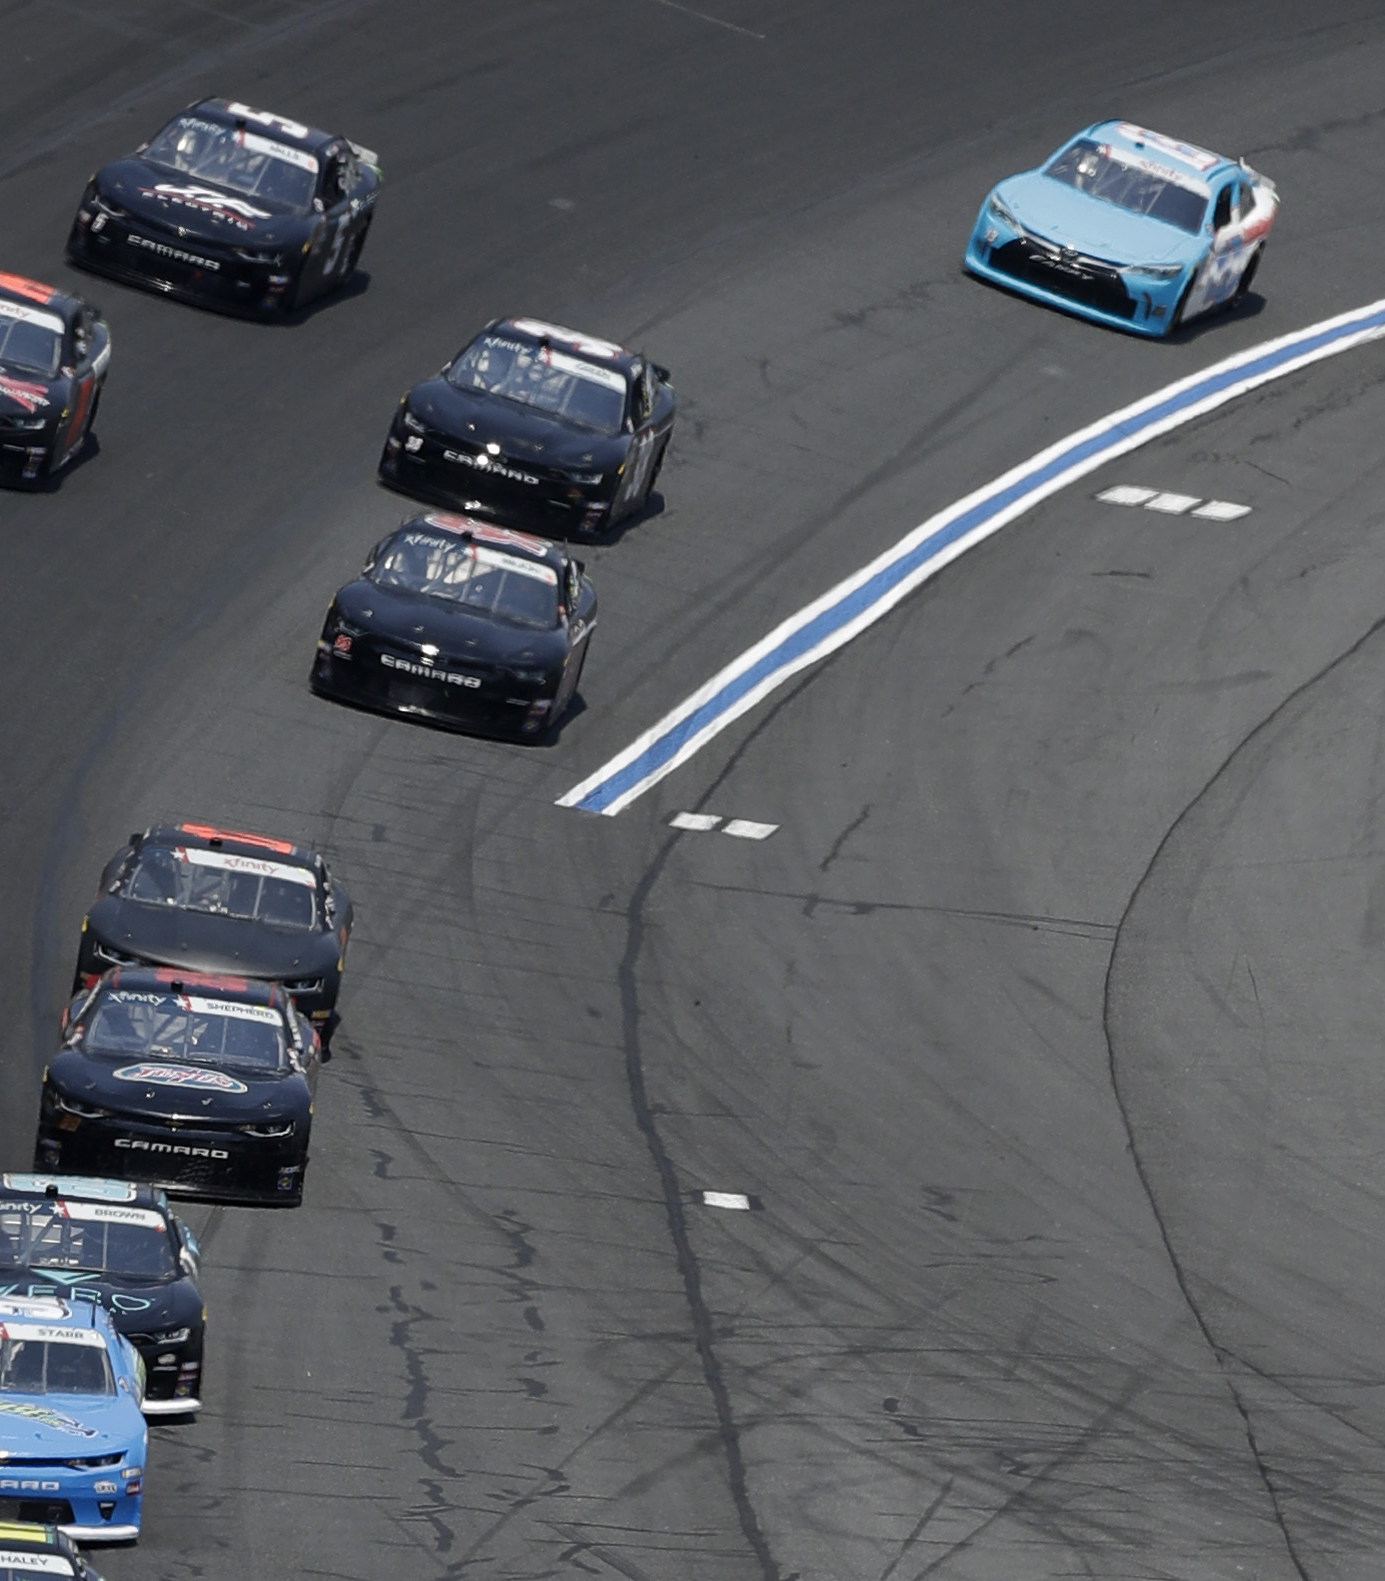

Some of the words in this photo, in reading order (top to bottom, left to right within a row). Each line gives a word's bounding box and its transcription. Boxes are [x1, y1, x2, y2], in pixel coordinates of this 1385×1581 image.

[207, 1002, 275, 1019] SHEPHERD
[115, 1138, 229, 1159] CAMARO
[95, 1209, 146, 1220] BROWN
[37, 1329, 84, 1340] STARR
[1, 1555, 49, 1566] HALEY
